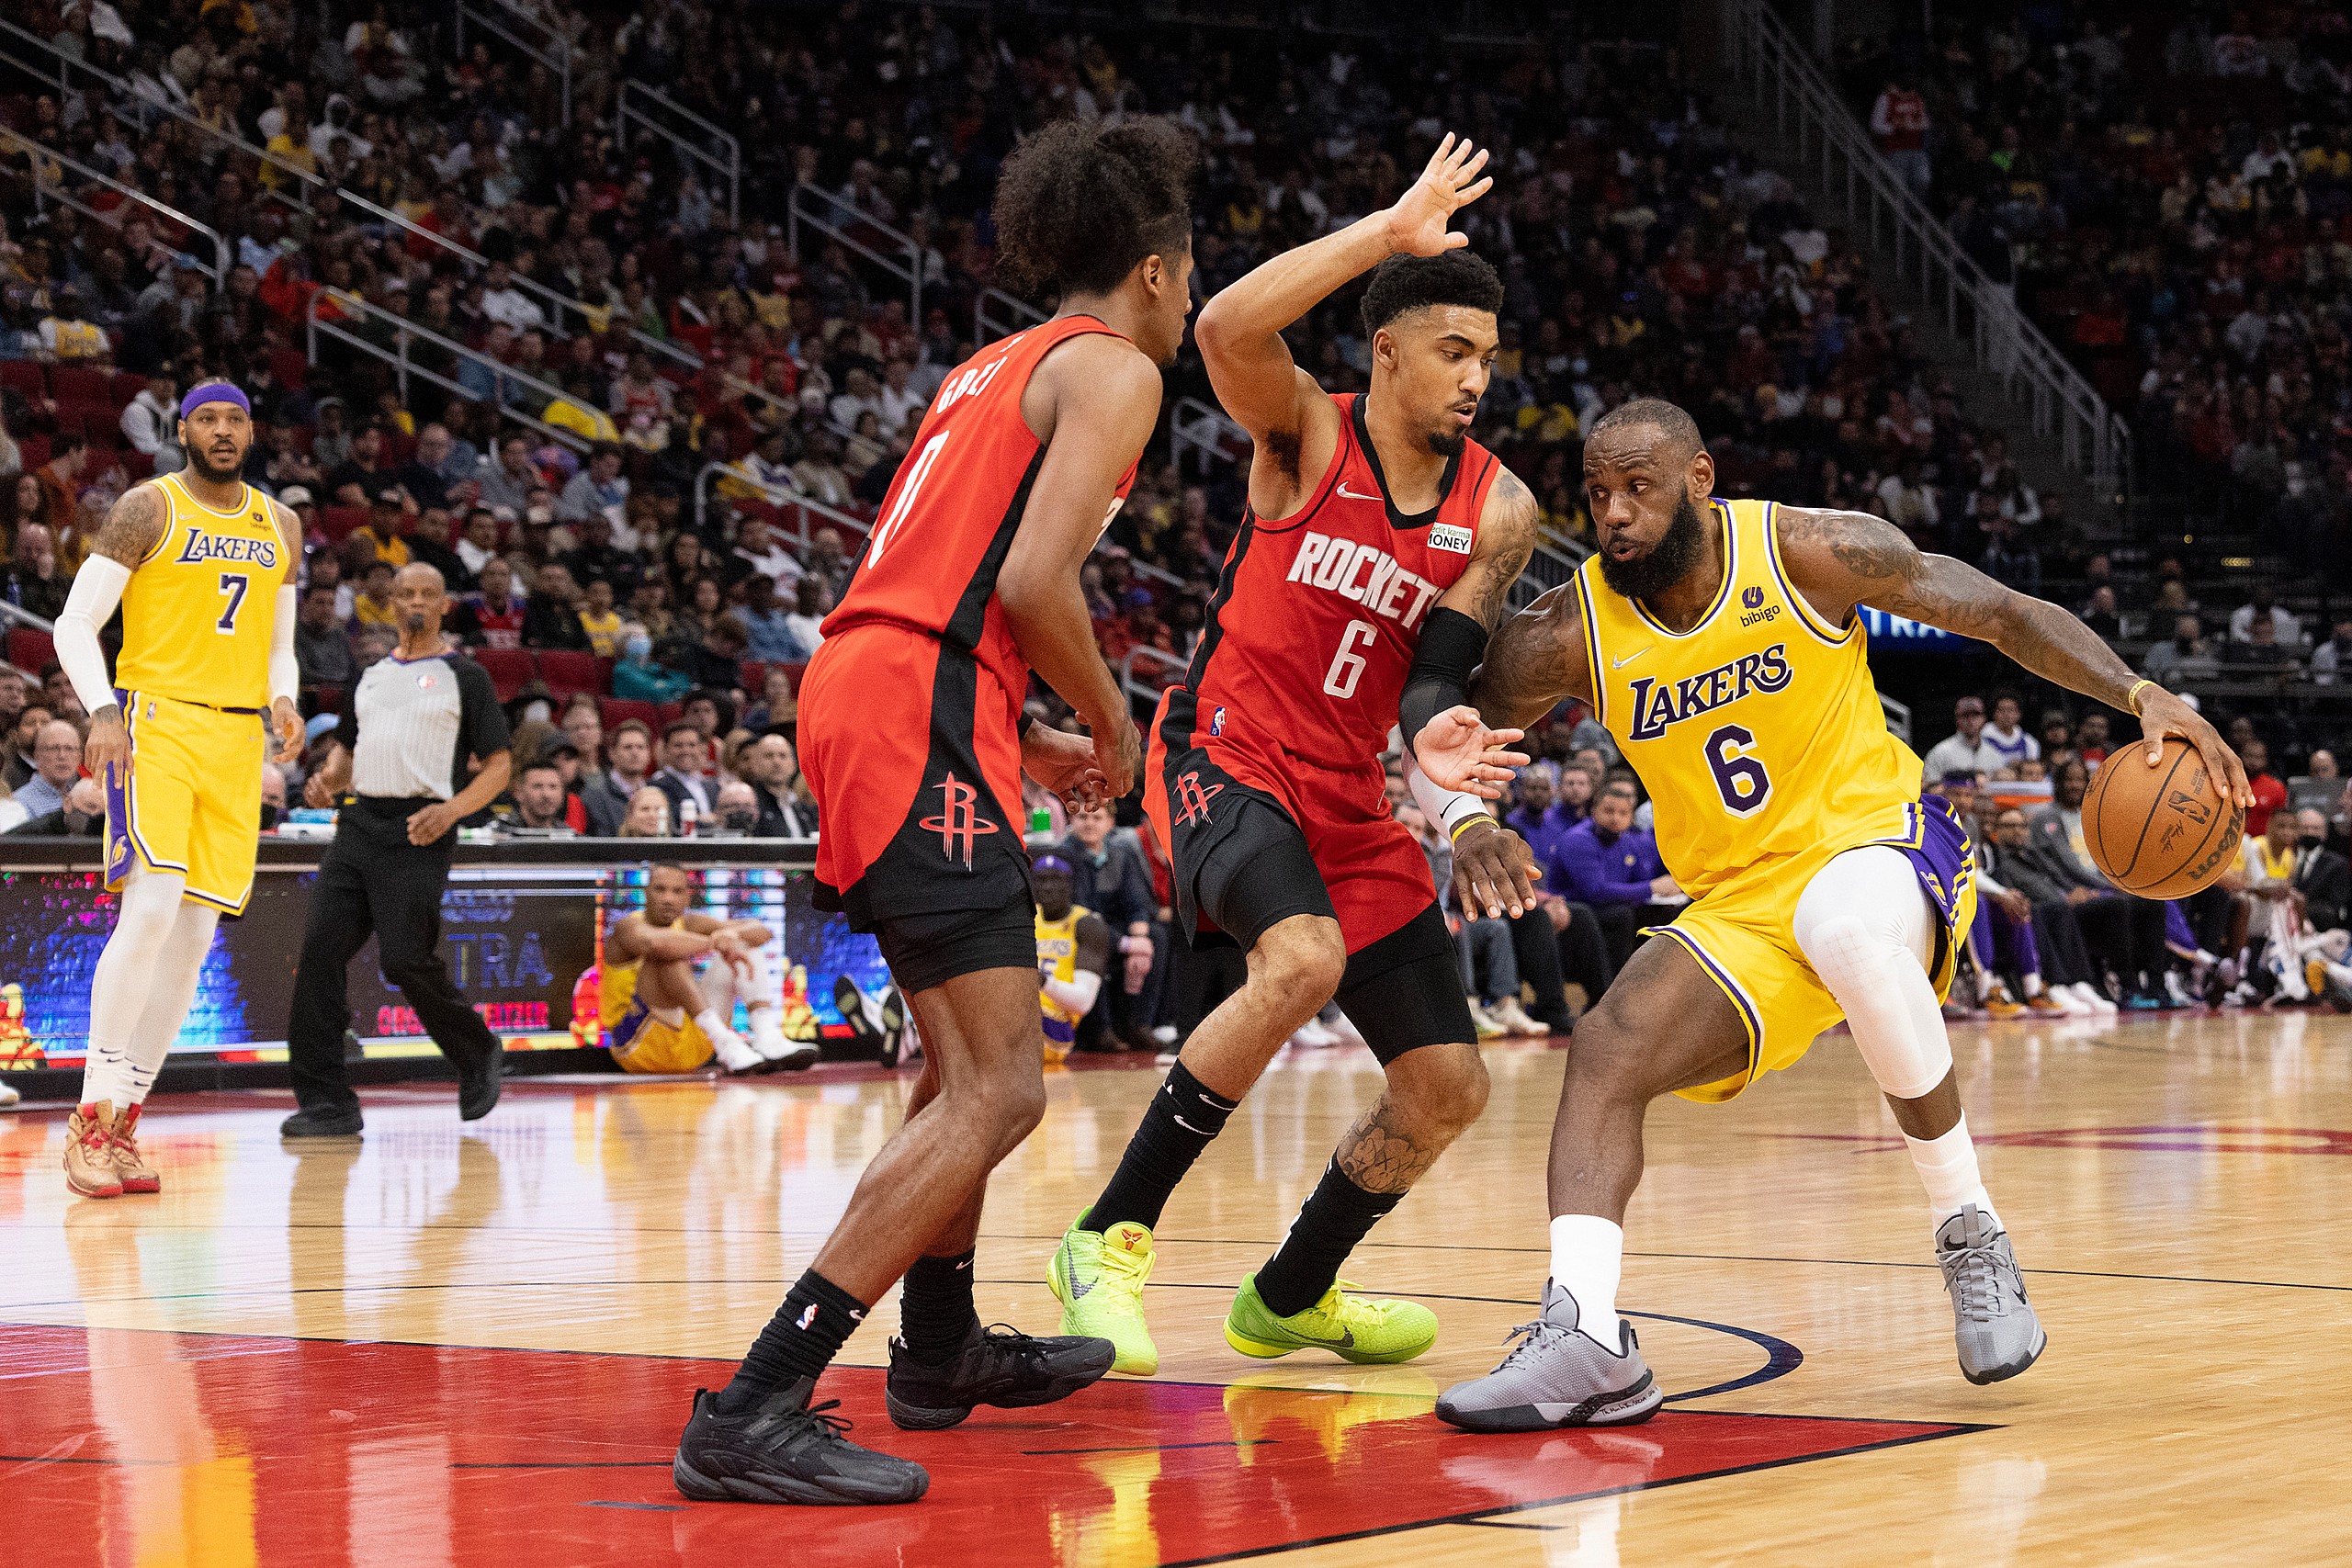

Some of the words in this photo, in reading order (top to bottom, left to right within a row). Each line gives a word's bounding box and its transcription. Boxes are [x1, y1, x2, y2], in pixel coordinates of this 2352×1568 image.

[174, 526, 277, 570] LAKERS
[1447, 527, 1471, 539] karma
[215, 571, 250, 636] 7
[1739, 603, 1781, 629] bibigo
[1323, 618, 1378, 699] 6
[1628, 642, 1794, 742] LAKERS
[1702, 721, 1774, 820] 6
